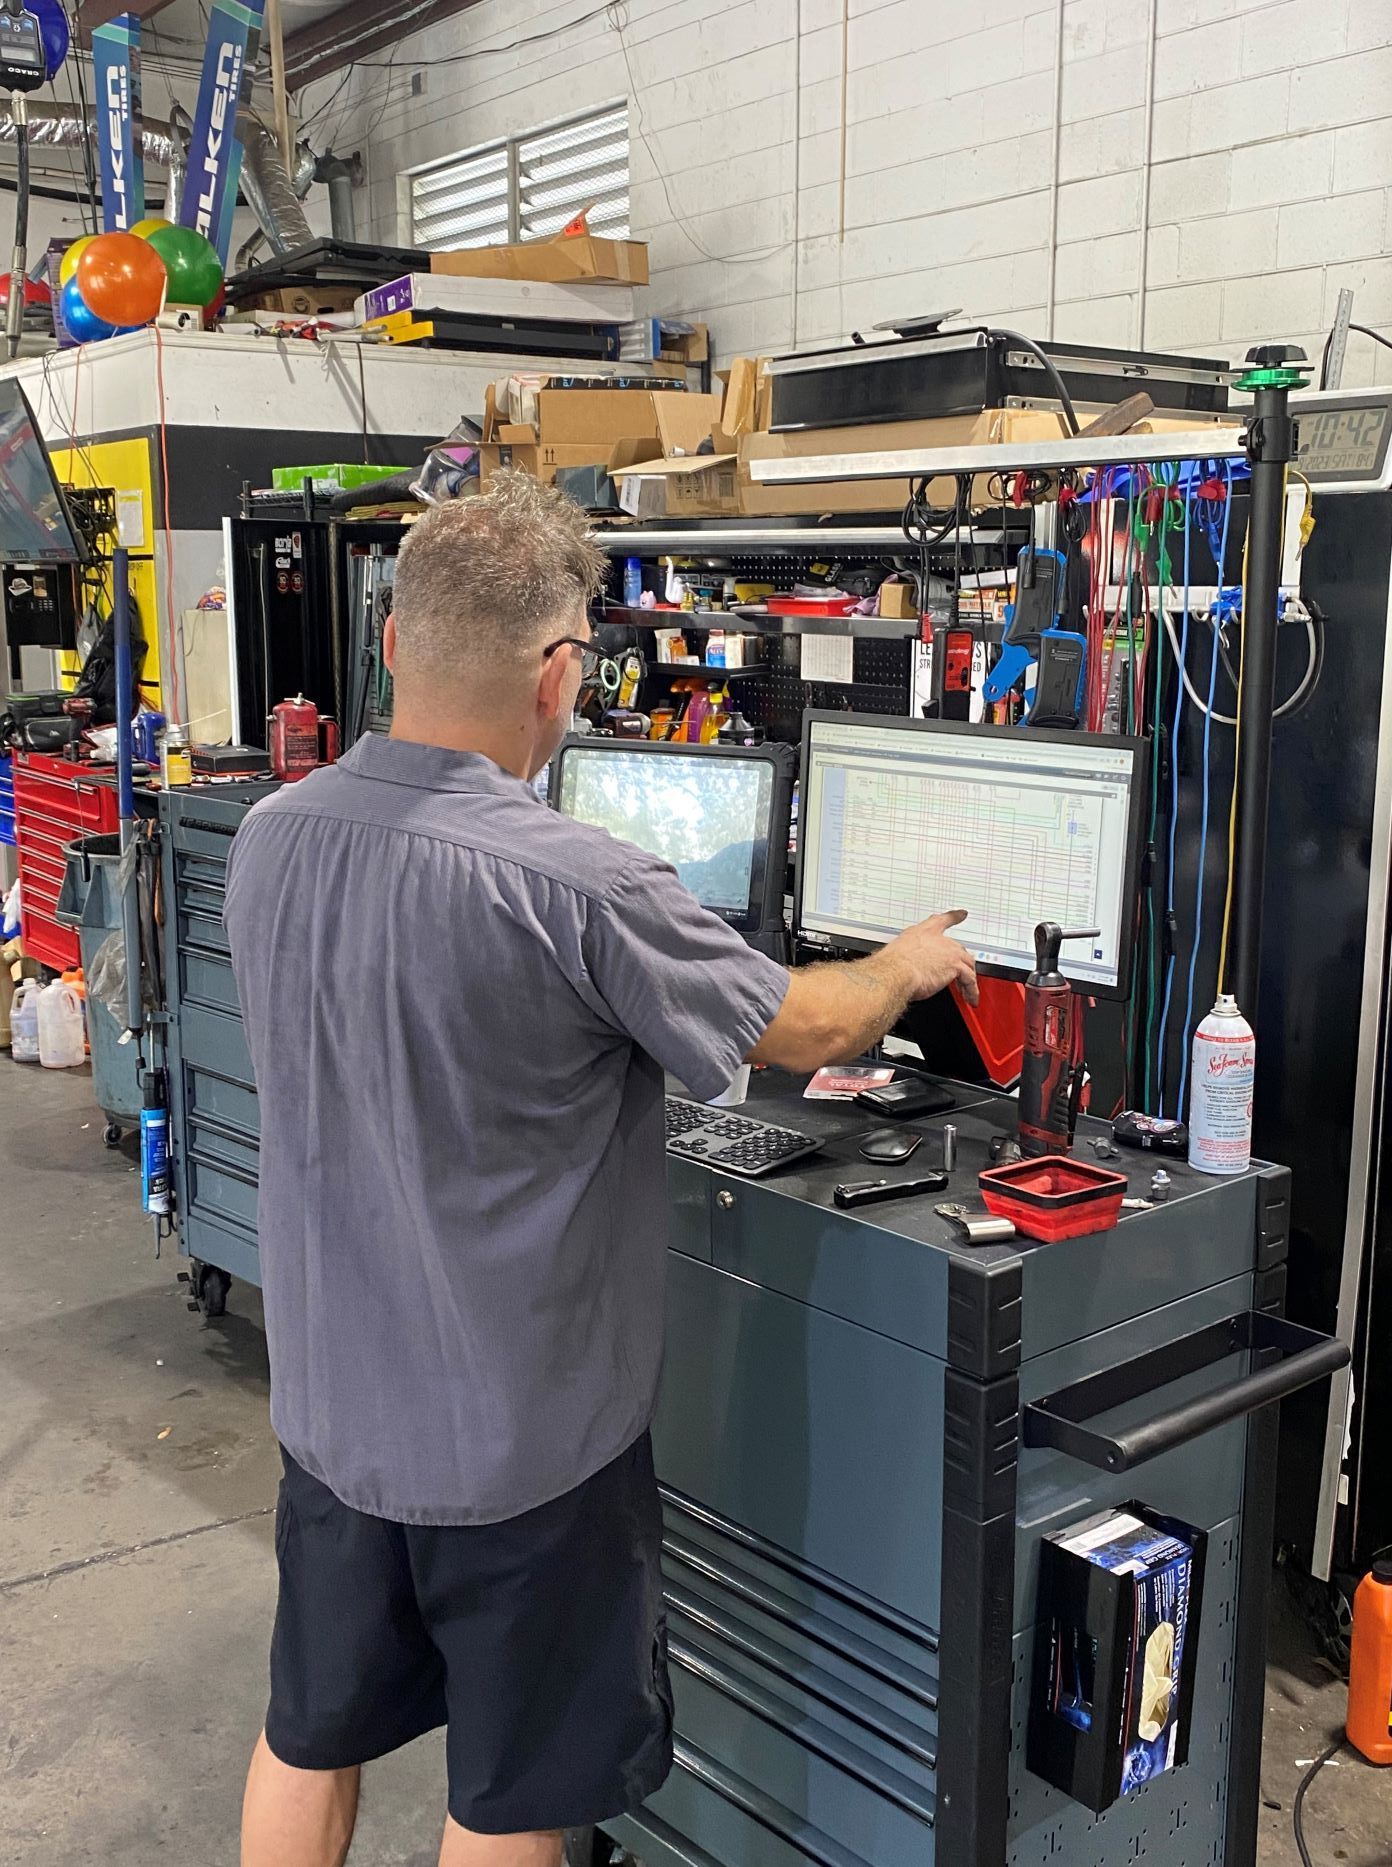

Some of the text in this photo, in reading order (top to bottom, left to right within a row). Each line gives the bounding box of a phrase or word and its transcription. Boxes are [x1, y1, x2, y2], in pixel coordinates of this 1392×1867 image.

[8, 66, 40, 76] GRACO
[228, 44, 242, 102] TIRES
[120, 64, 128, 122] TIRES
[106, 66, 127, 230] LKEN
[196, 42, 234, 239] ALKEN
[1310, 411, 1385, 448] 10:42
[798, 930, 817, 938] HDMI
[1208, 1056, 1220, 1074] Sea
[1213, 1054, 1240, 1077] Foam
[1174, 1562, 1186, 1651] DIAMOND
[1170, 1655, 1180, 1696] GRIP
